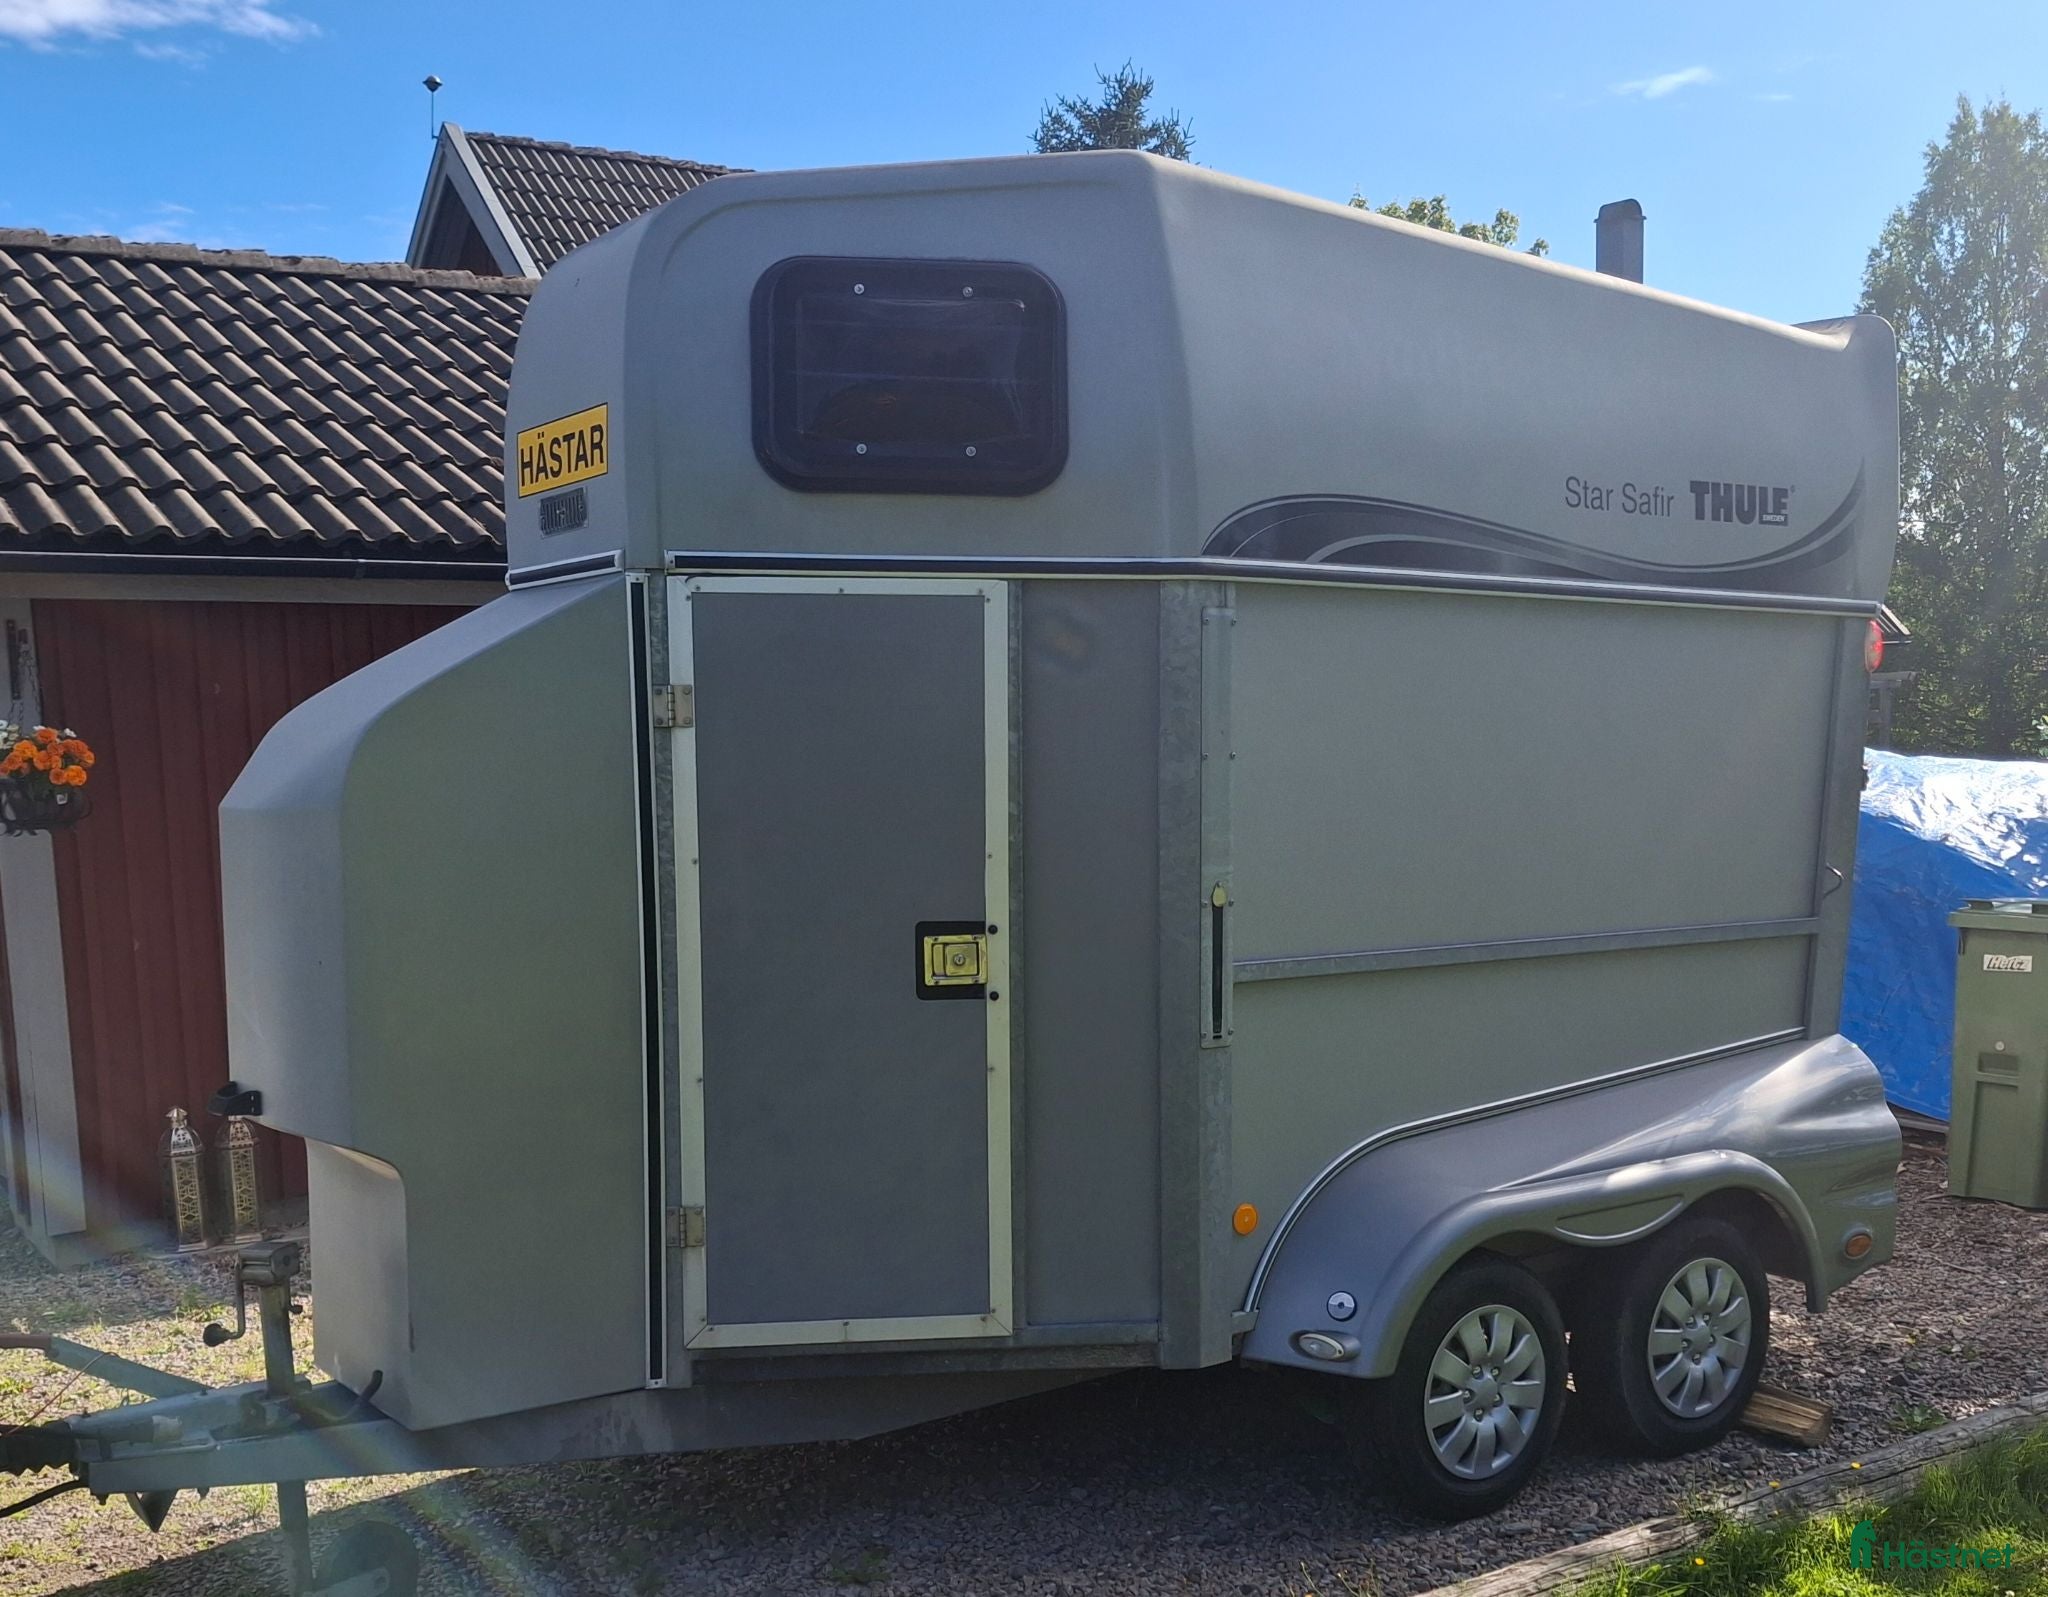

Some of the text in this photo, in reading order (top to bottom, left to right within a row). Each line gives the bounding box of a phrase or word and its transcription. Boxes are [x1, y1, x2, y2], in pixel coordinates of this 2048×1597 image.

[520, 424, 604, 487] HÄSTAR
[1565, 476, 1674, 517] Star Safir
[1690, 480, 1788, 526] THULE
